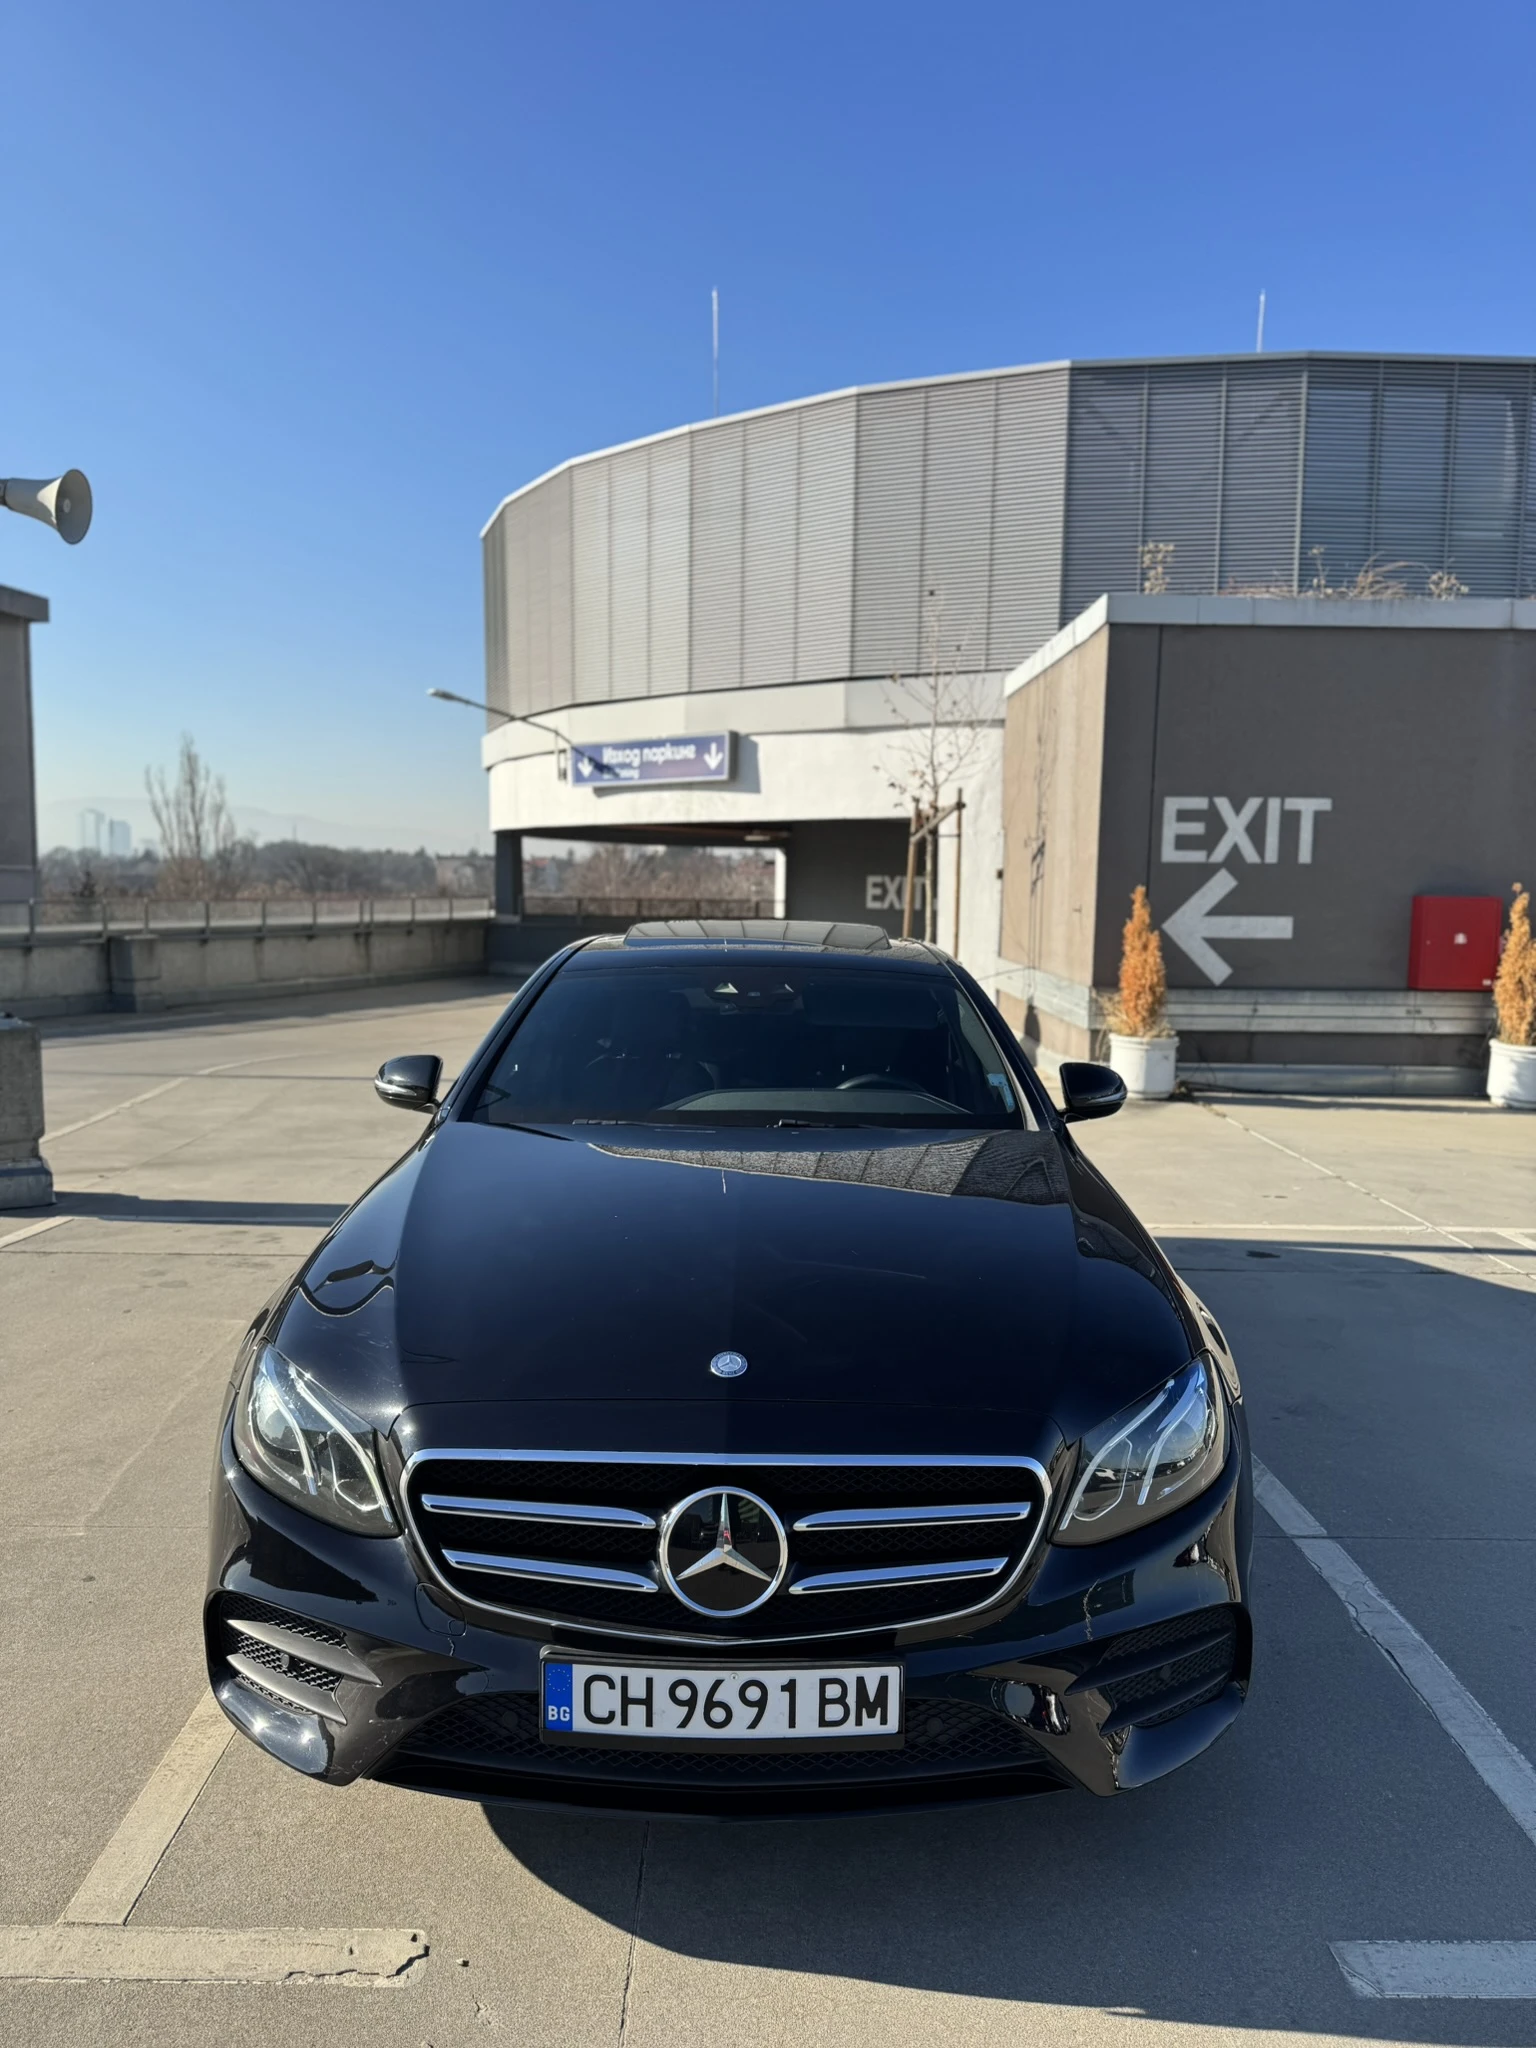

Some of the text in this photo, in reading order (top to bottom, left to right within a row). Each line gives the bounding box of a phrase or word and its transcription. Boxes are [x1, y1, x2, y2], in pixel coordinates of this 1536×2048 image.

[1161, 797, 1332, 864] EXIT
[547, 1705, 571, 1723] BG
[583, 1674, 889, 1731] CH 9691 BM
